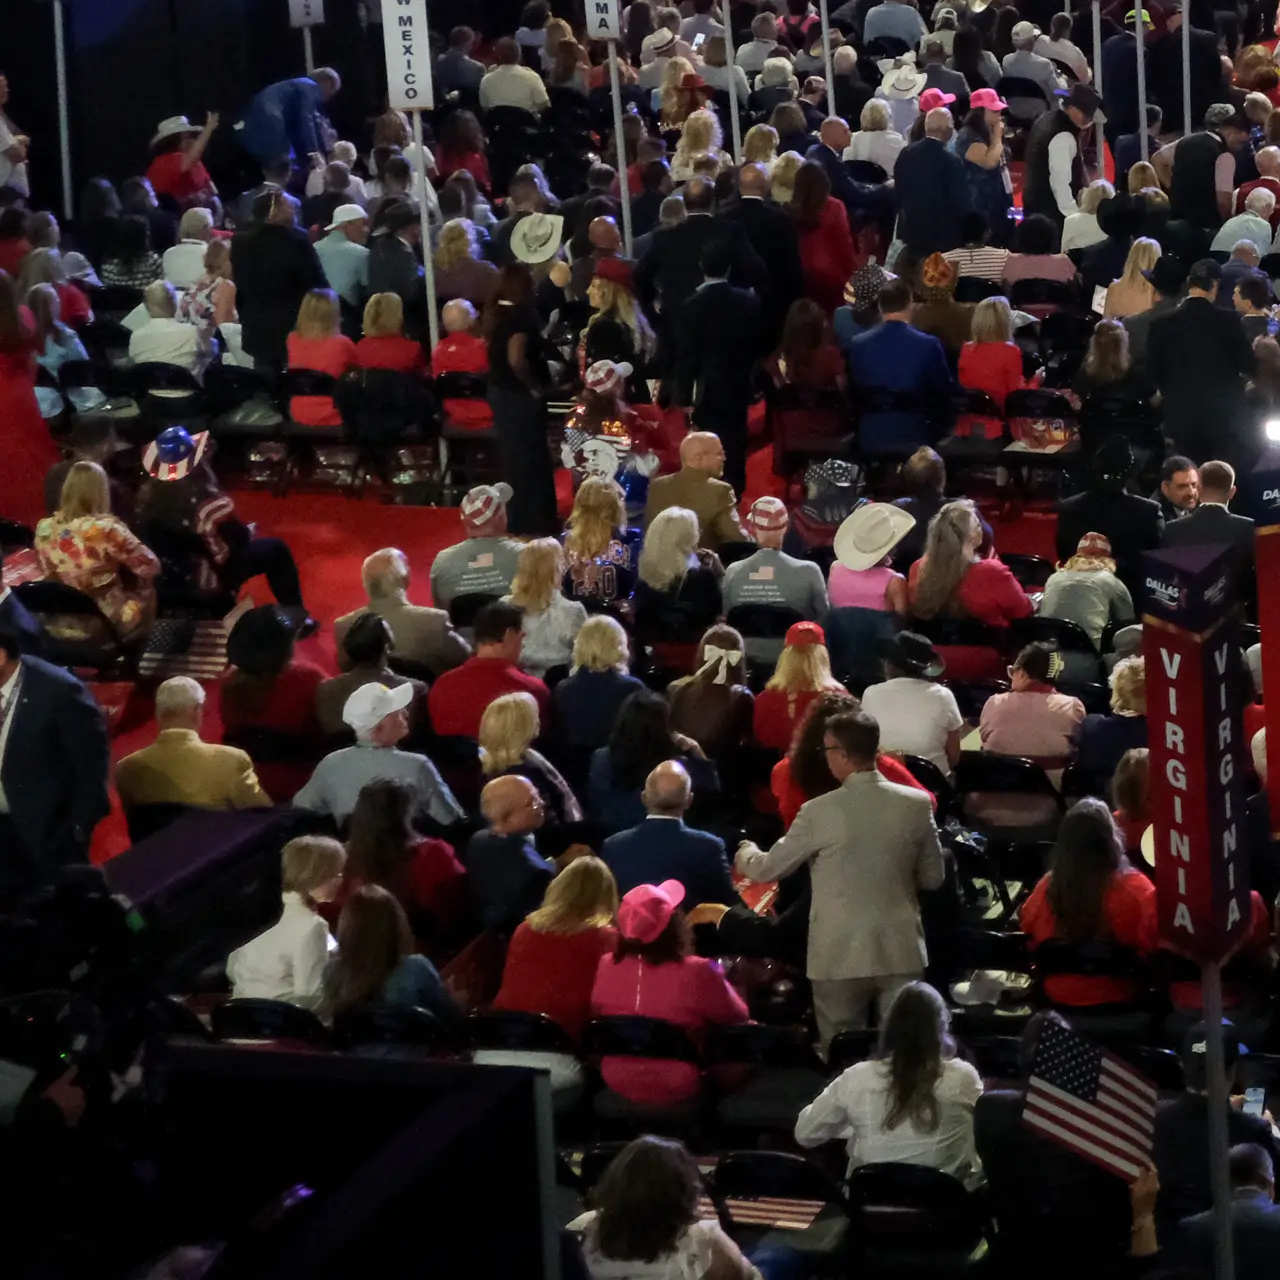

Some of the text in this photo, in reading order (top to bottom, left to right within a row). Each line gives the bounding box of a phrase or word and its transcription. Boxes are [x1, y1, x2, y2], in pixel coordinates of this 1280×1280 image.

[398, 16, 418, 100] MEXICO
[1146, 577, 1179, 598] DALLAS
[1160, 646, 1195, 934] VIRGINIA
[1213, 641, 1241, 932] VIRGINIA
